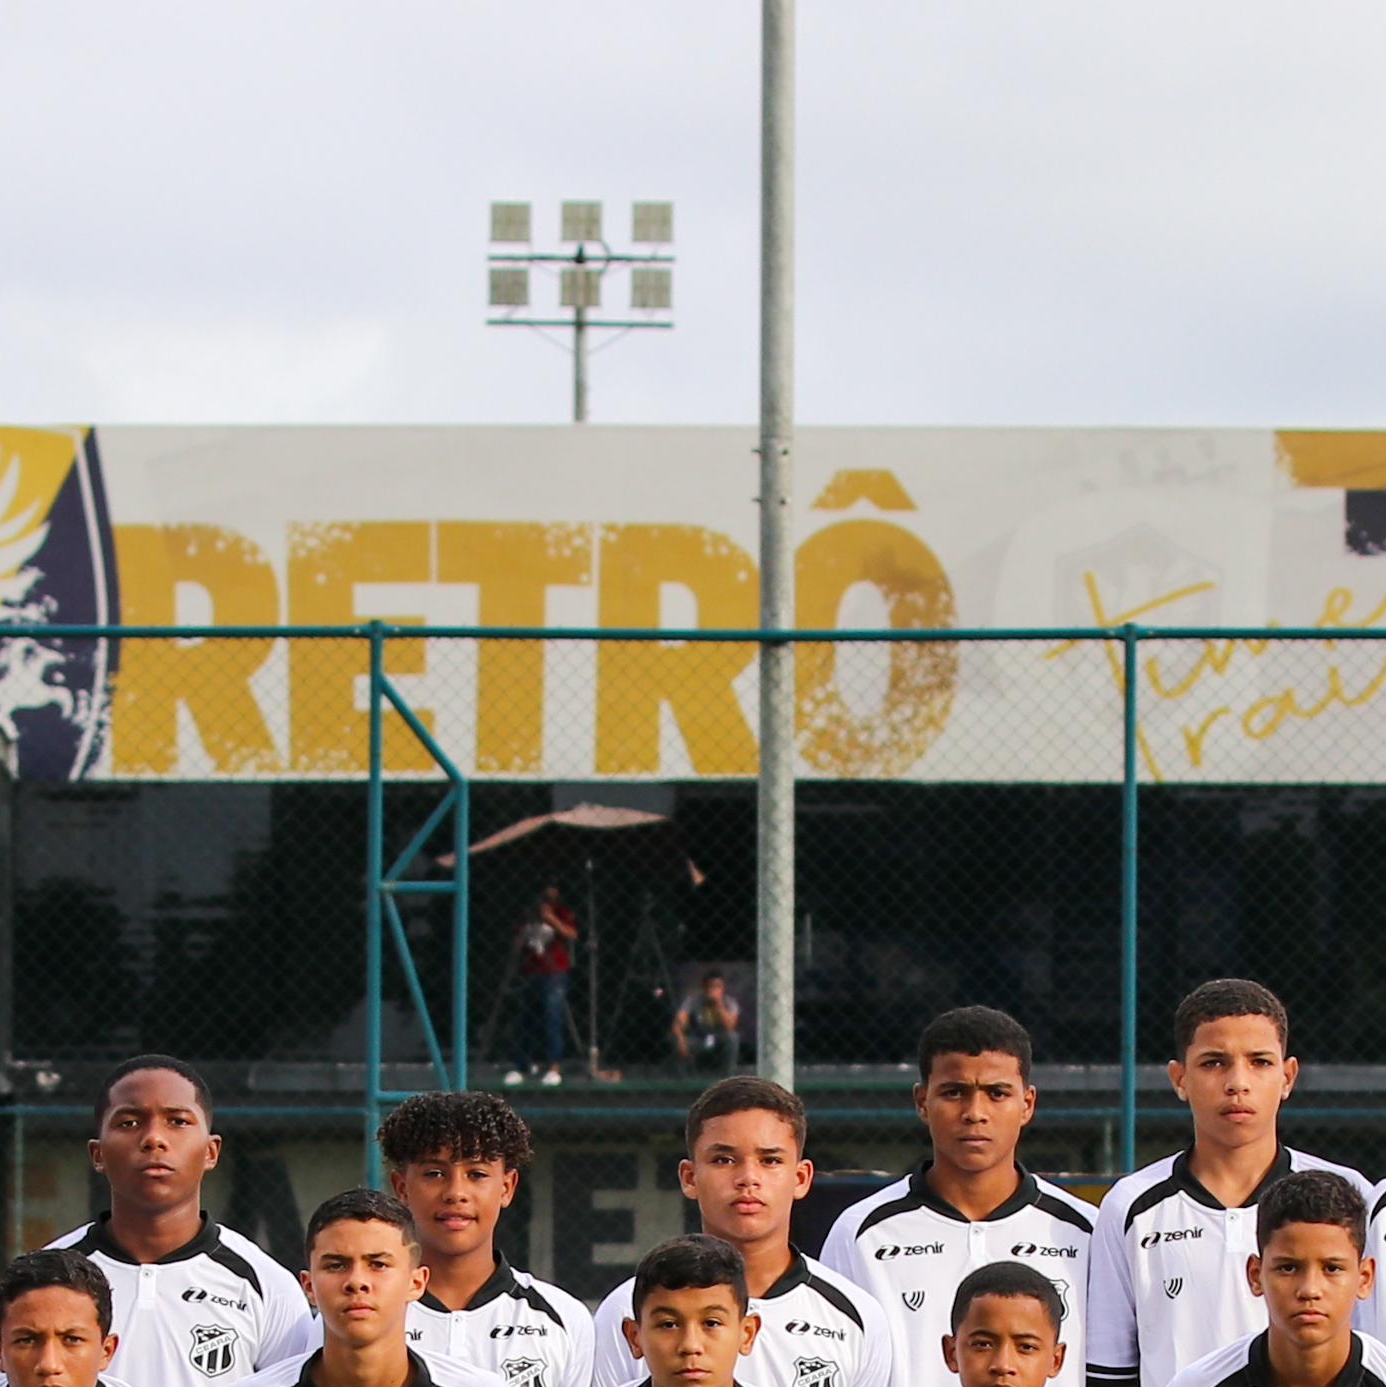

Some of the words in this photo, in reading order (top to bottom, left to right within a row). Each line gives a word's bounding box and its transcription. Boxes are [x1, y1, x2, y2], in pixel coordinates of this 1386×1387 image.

[110, 469, 958, 778] RETRÔ
[1164, 1226, 1205, 1242] zenir
[903, 1241, 945, 1256] zenir
[1039, 1245, 1078, 1258] zenir
[813, 1325, 847, 1342] zenir
